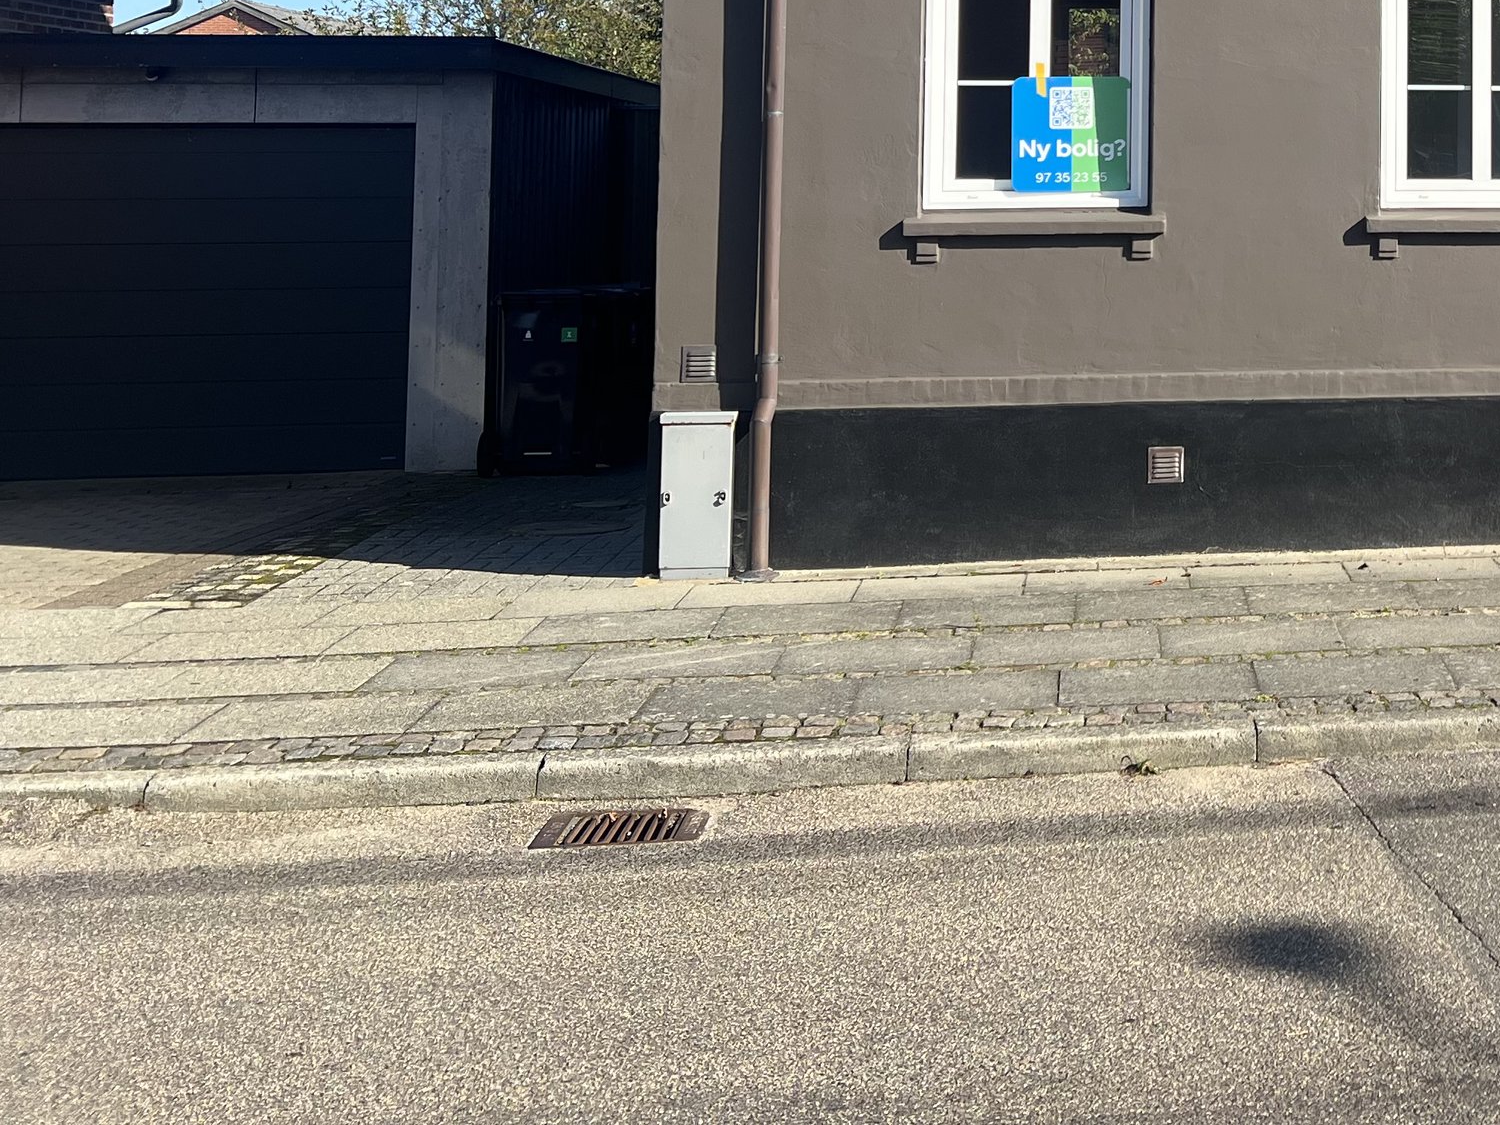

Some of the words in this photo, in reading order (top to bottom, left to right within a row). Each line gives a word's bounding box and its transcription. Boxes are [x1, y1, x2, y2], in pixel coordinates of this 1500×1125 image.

[1019, 139, 1051, 162] Ny
[1056, 139, 1126, 162] bolig?
[1035, 172, 1052, 183] 97
[1055, 172, 1071, 183] 35
[1073, 172, 1089, 183] 23
[1092, 172, 1108, 183] 55
